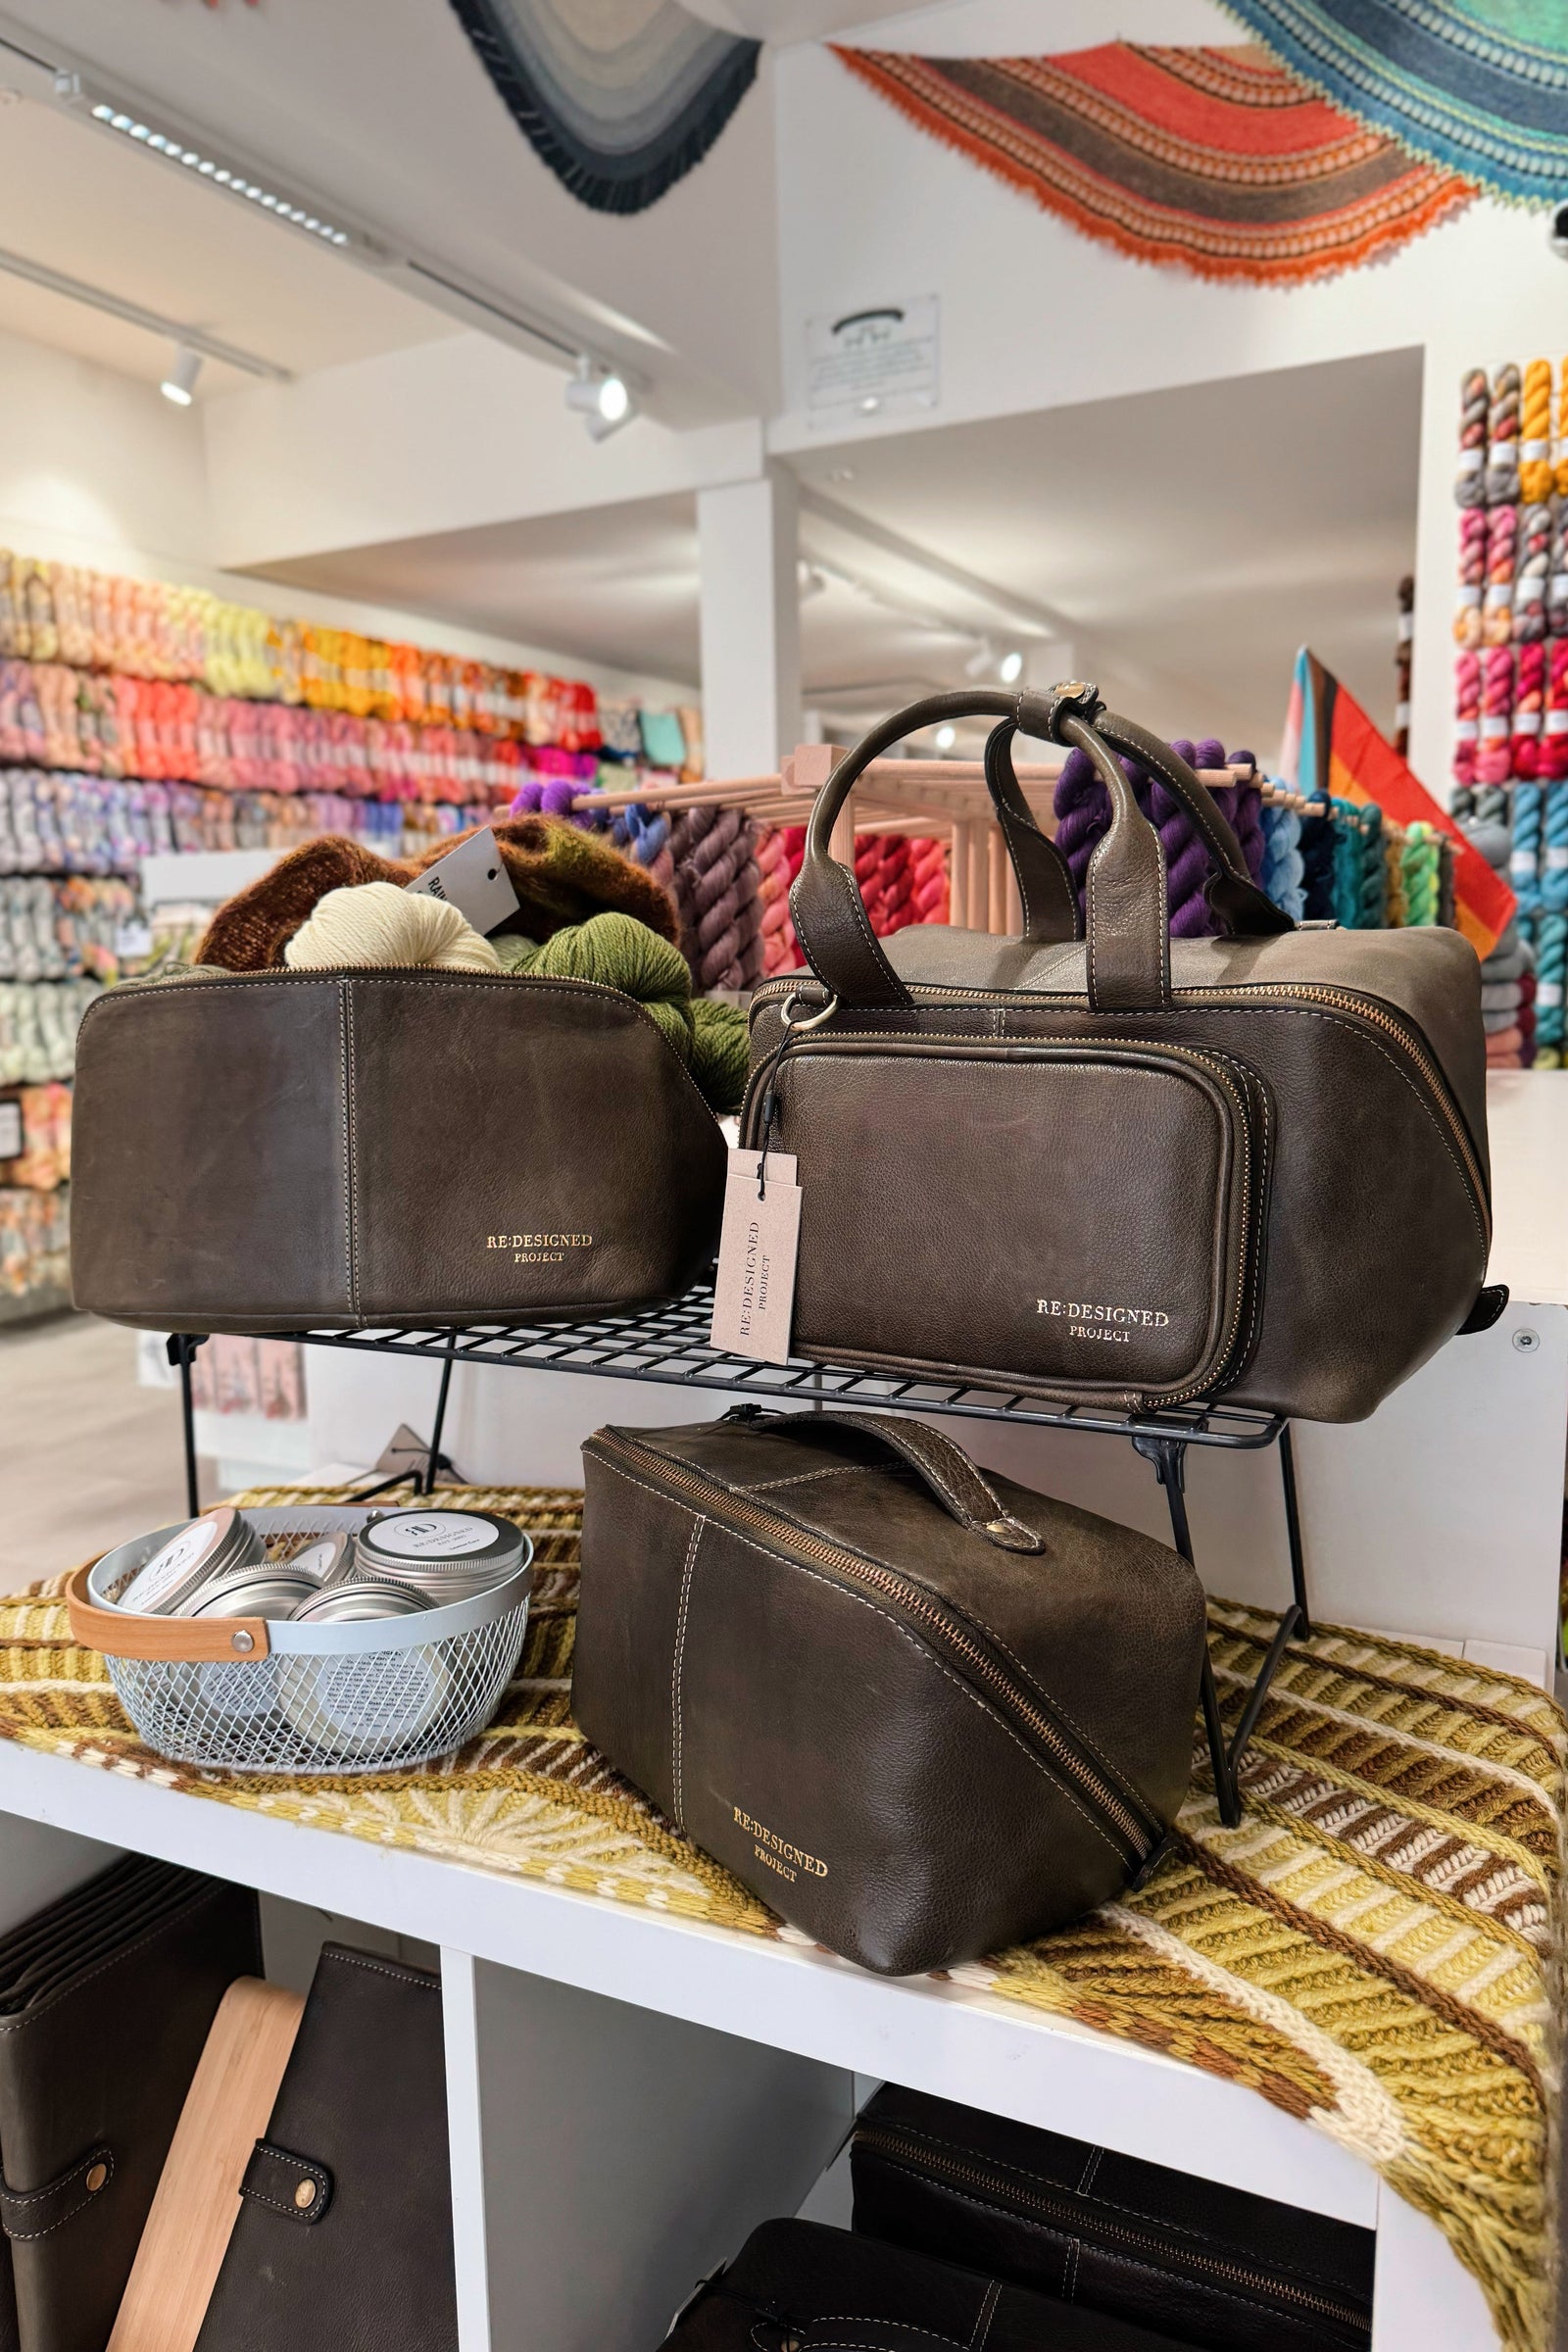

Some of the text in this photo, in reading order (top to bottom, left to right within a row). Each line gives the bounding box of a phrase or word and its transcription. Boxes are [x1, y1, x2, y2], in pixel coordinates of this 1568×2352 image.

[486, 1234, 593, 1249] RE:DESIGNED
[514, 1252, 564, 1263] PROJECT
[740, 1221, 760, 1336] RE:DESIGNED
[758, 1255, 770, 1310] PROJECT
[1036, 1298, 1170, 1327] RE:DESIGNED
[1069, 1325, 1131, 1343] PROJECT
[733, 1806, 829, 1878] RE:DESIGNED
[754, 1844, 798, 1883] PROJECT
